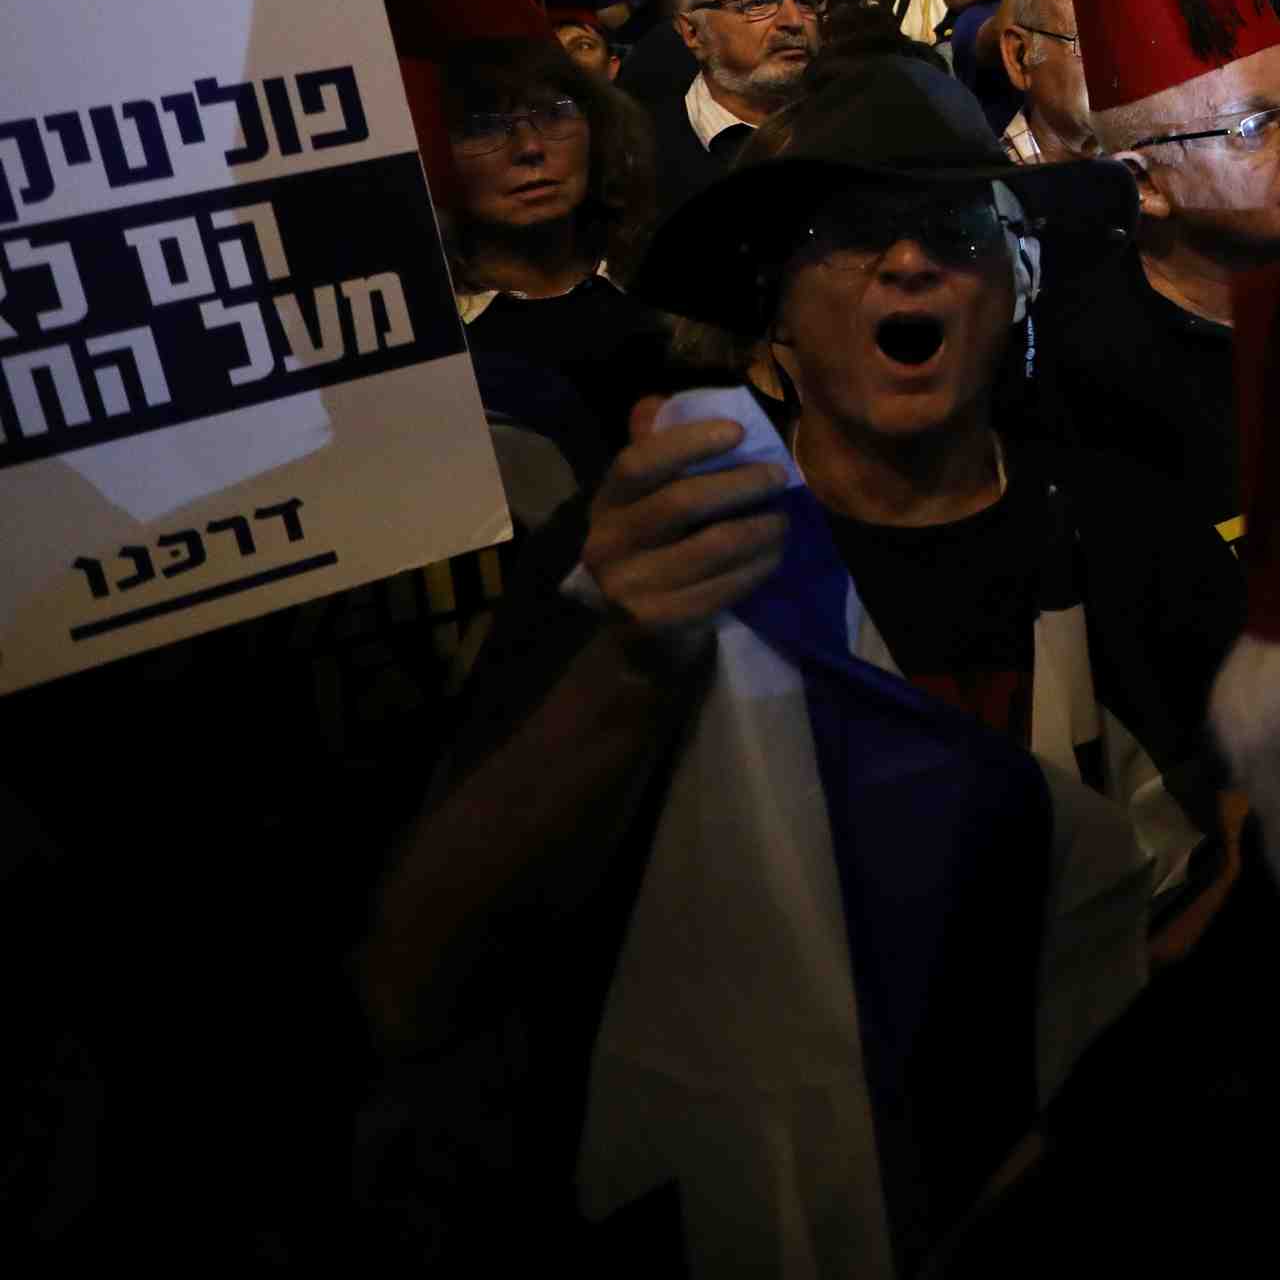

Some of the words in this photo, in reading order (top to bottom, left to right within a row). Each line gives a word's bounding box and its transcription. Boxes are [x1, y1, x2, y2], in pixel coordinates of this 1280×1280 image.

[0, 66, 369, 222] פוליטיק
[124, 200, 292, 308] הם
[0, 325, 172, 447] הח
[200, 270, 416, 386] מעל
